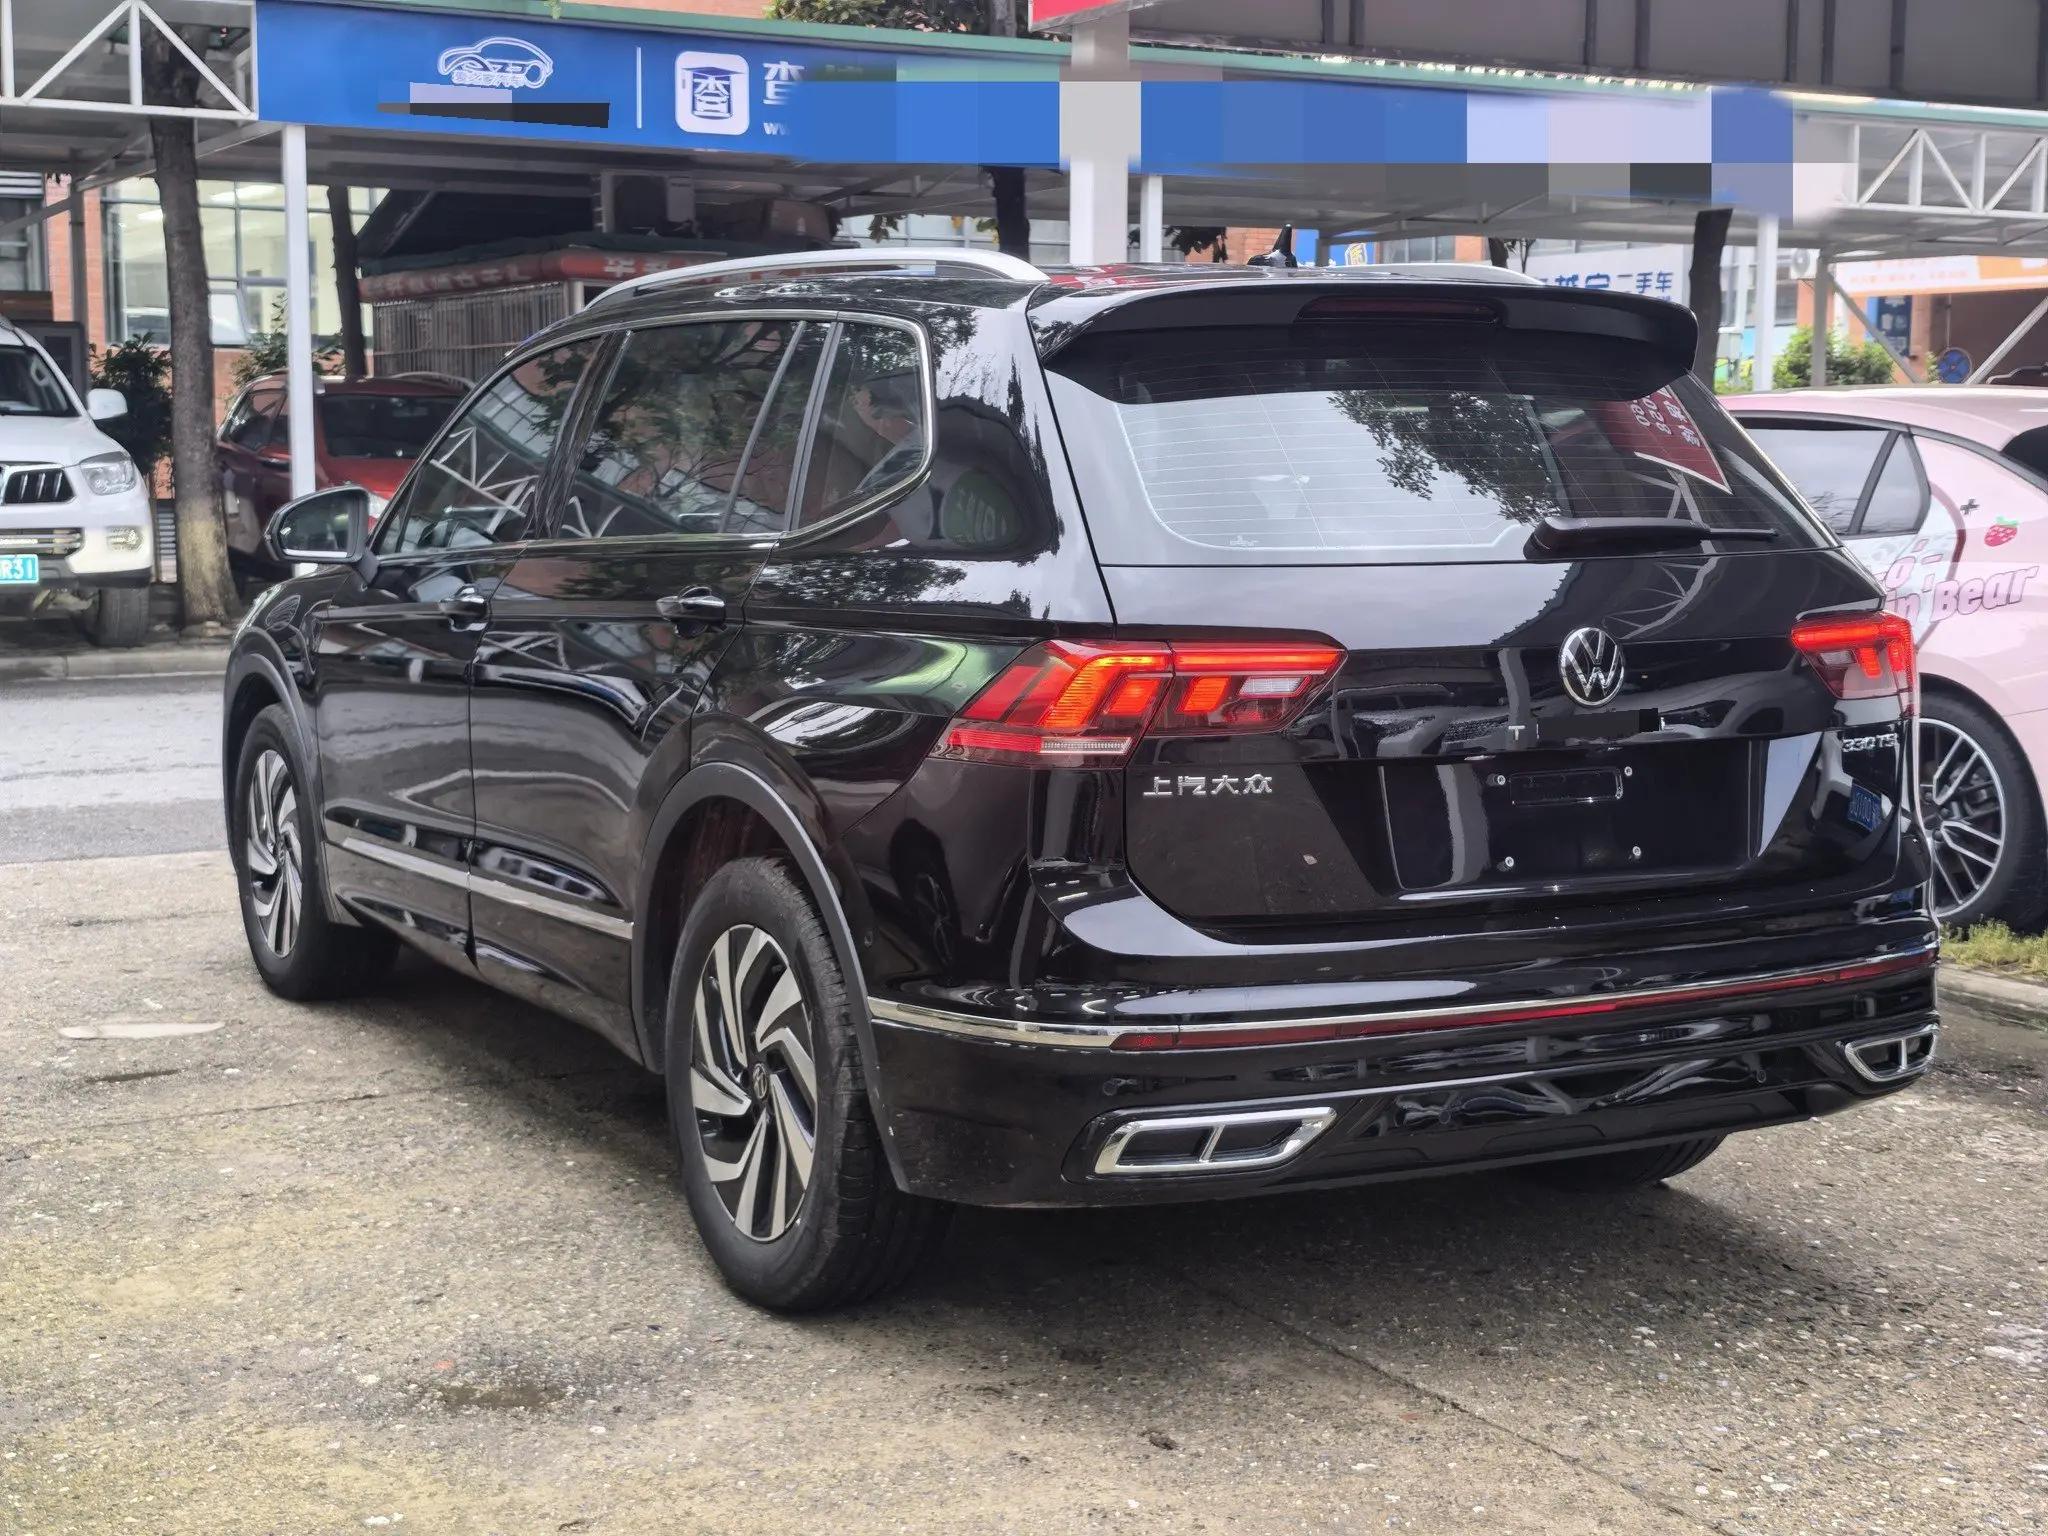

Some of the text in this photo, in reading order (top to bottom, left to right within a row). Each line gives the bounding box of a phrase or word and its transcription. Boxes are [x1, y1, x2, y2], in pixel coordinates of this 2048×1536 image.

[1929, 565, 2040, 623] Bear
[1142, 772, 1273, 797] 上汽大众
